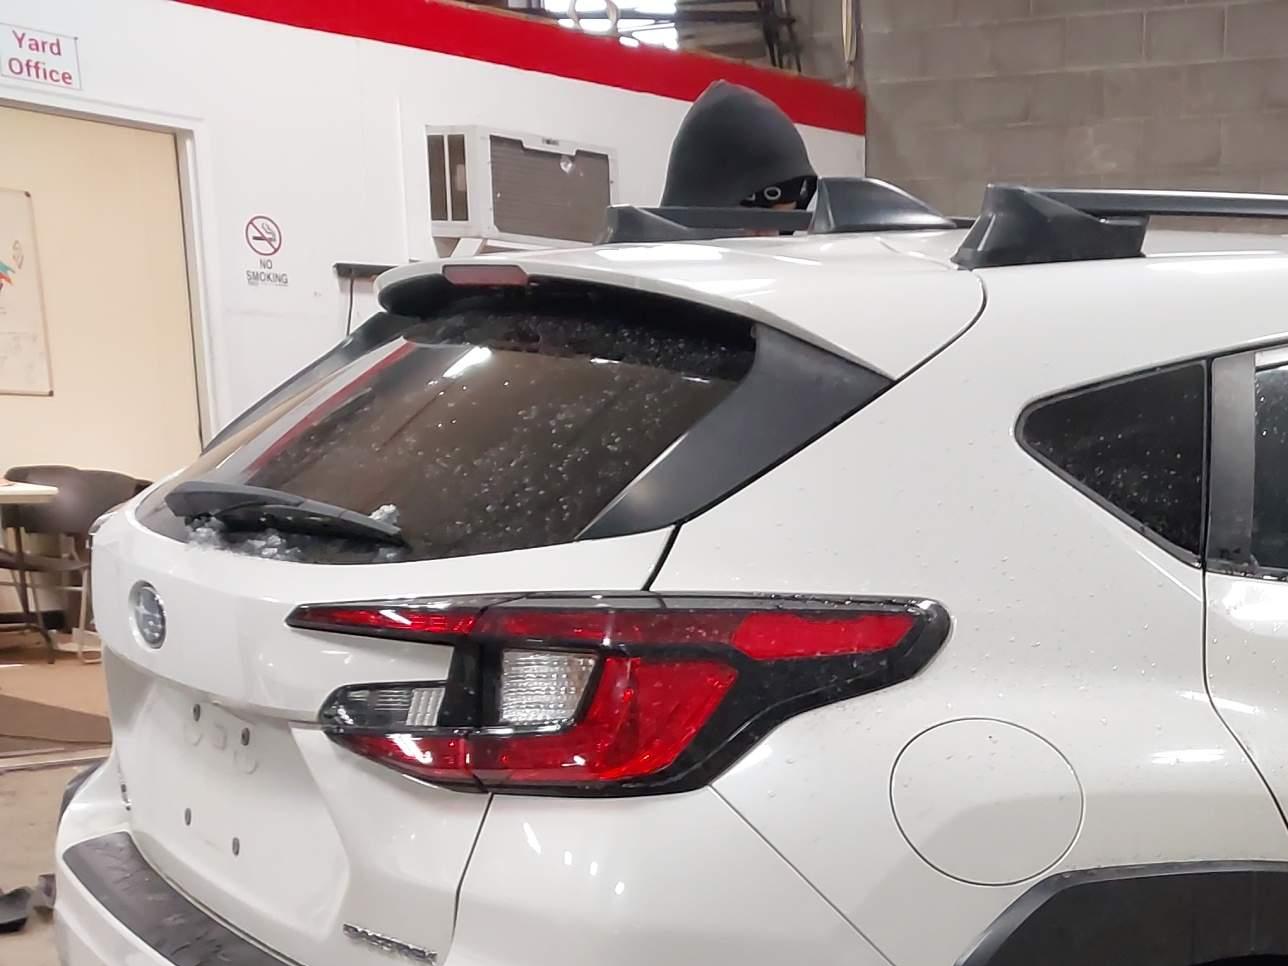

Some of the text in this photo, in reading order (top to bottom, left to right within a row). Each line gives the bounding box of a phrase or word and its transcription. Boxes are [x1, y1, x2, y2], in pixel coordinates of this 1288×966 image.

[12, 29, 62, 56] Yard
[8, 57, 73, 85] Office
[259, 258, 273, 270] NO
[246, 270, 289, 284] SMOKING
